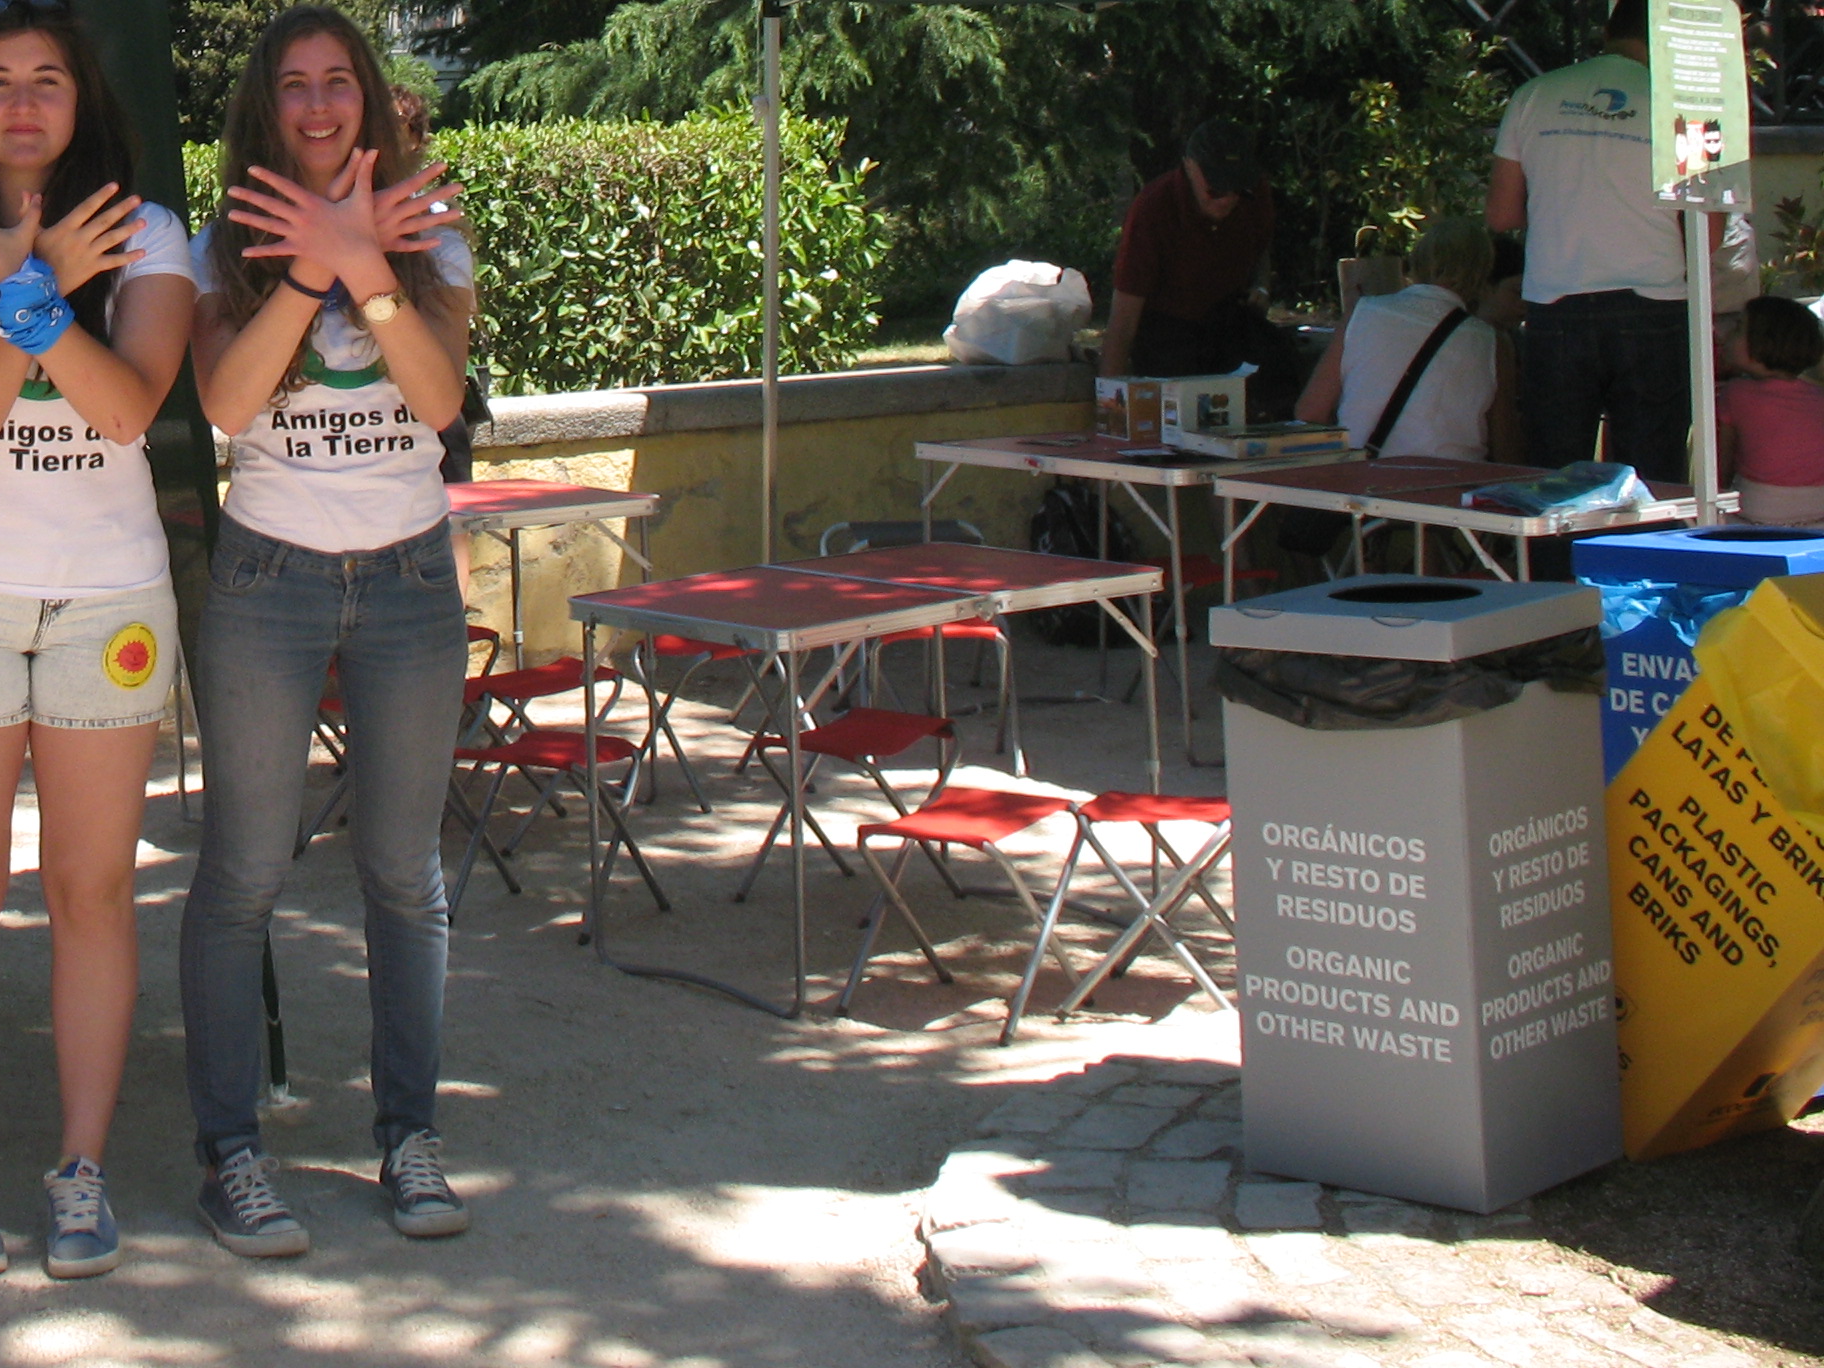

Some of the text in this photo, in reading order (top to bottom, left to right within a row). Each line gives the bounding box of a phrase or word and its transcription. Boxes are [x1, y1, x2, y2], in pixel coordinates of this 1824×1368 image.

[271, 408, 384, 433] Amigos
[9, 448, 104, 472] Tierra
[285, 435, 414, 457] la Tierra
[1610, 687, 1645, 714] DE
[1700, 704, 1734, 747] DE
[1489, 805, 1589, 858] ORGÁNICOS
[1671, 720, 1750, 805] LATAS
[1750, 800, 1773, 825] Y
[1768, 825, 1824, 904] BRIK
[1262, 823, 1426, 863] ORGÁNICOS
[1492, 842, 1590, 894] Y RESTO DE
[1678, 795, 1776, 905] PLASTIC
[1265, 857, 1426, 899] Y RESTO DE
[1628, 788, 1780, 968] PACKAGINGS,
[1628, 835, 1744, 966] CANS AND
[1277, 894, 1417, 933] RESIDUOS
[1500, 880, 1586, 929] RESIDUOS
[1628, 882, 1701, 965] BRIKS
[1286, 945, 1412, 984] ORGANIC
[1507, 932, 1584, 979] ORGANIC
[1245, 974, 1460, 1027] PRODUCTS AND
[1482, 959, 1612, 1027] PRODUCTS AND
[1256, 1011, 1452, 1063] OTHER WASTE
[1490, 996, 1608, 1059] OTHER WASTE
